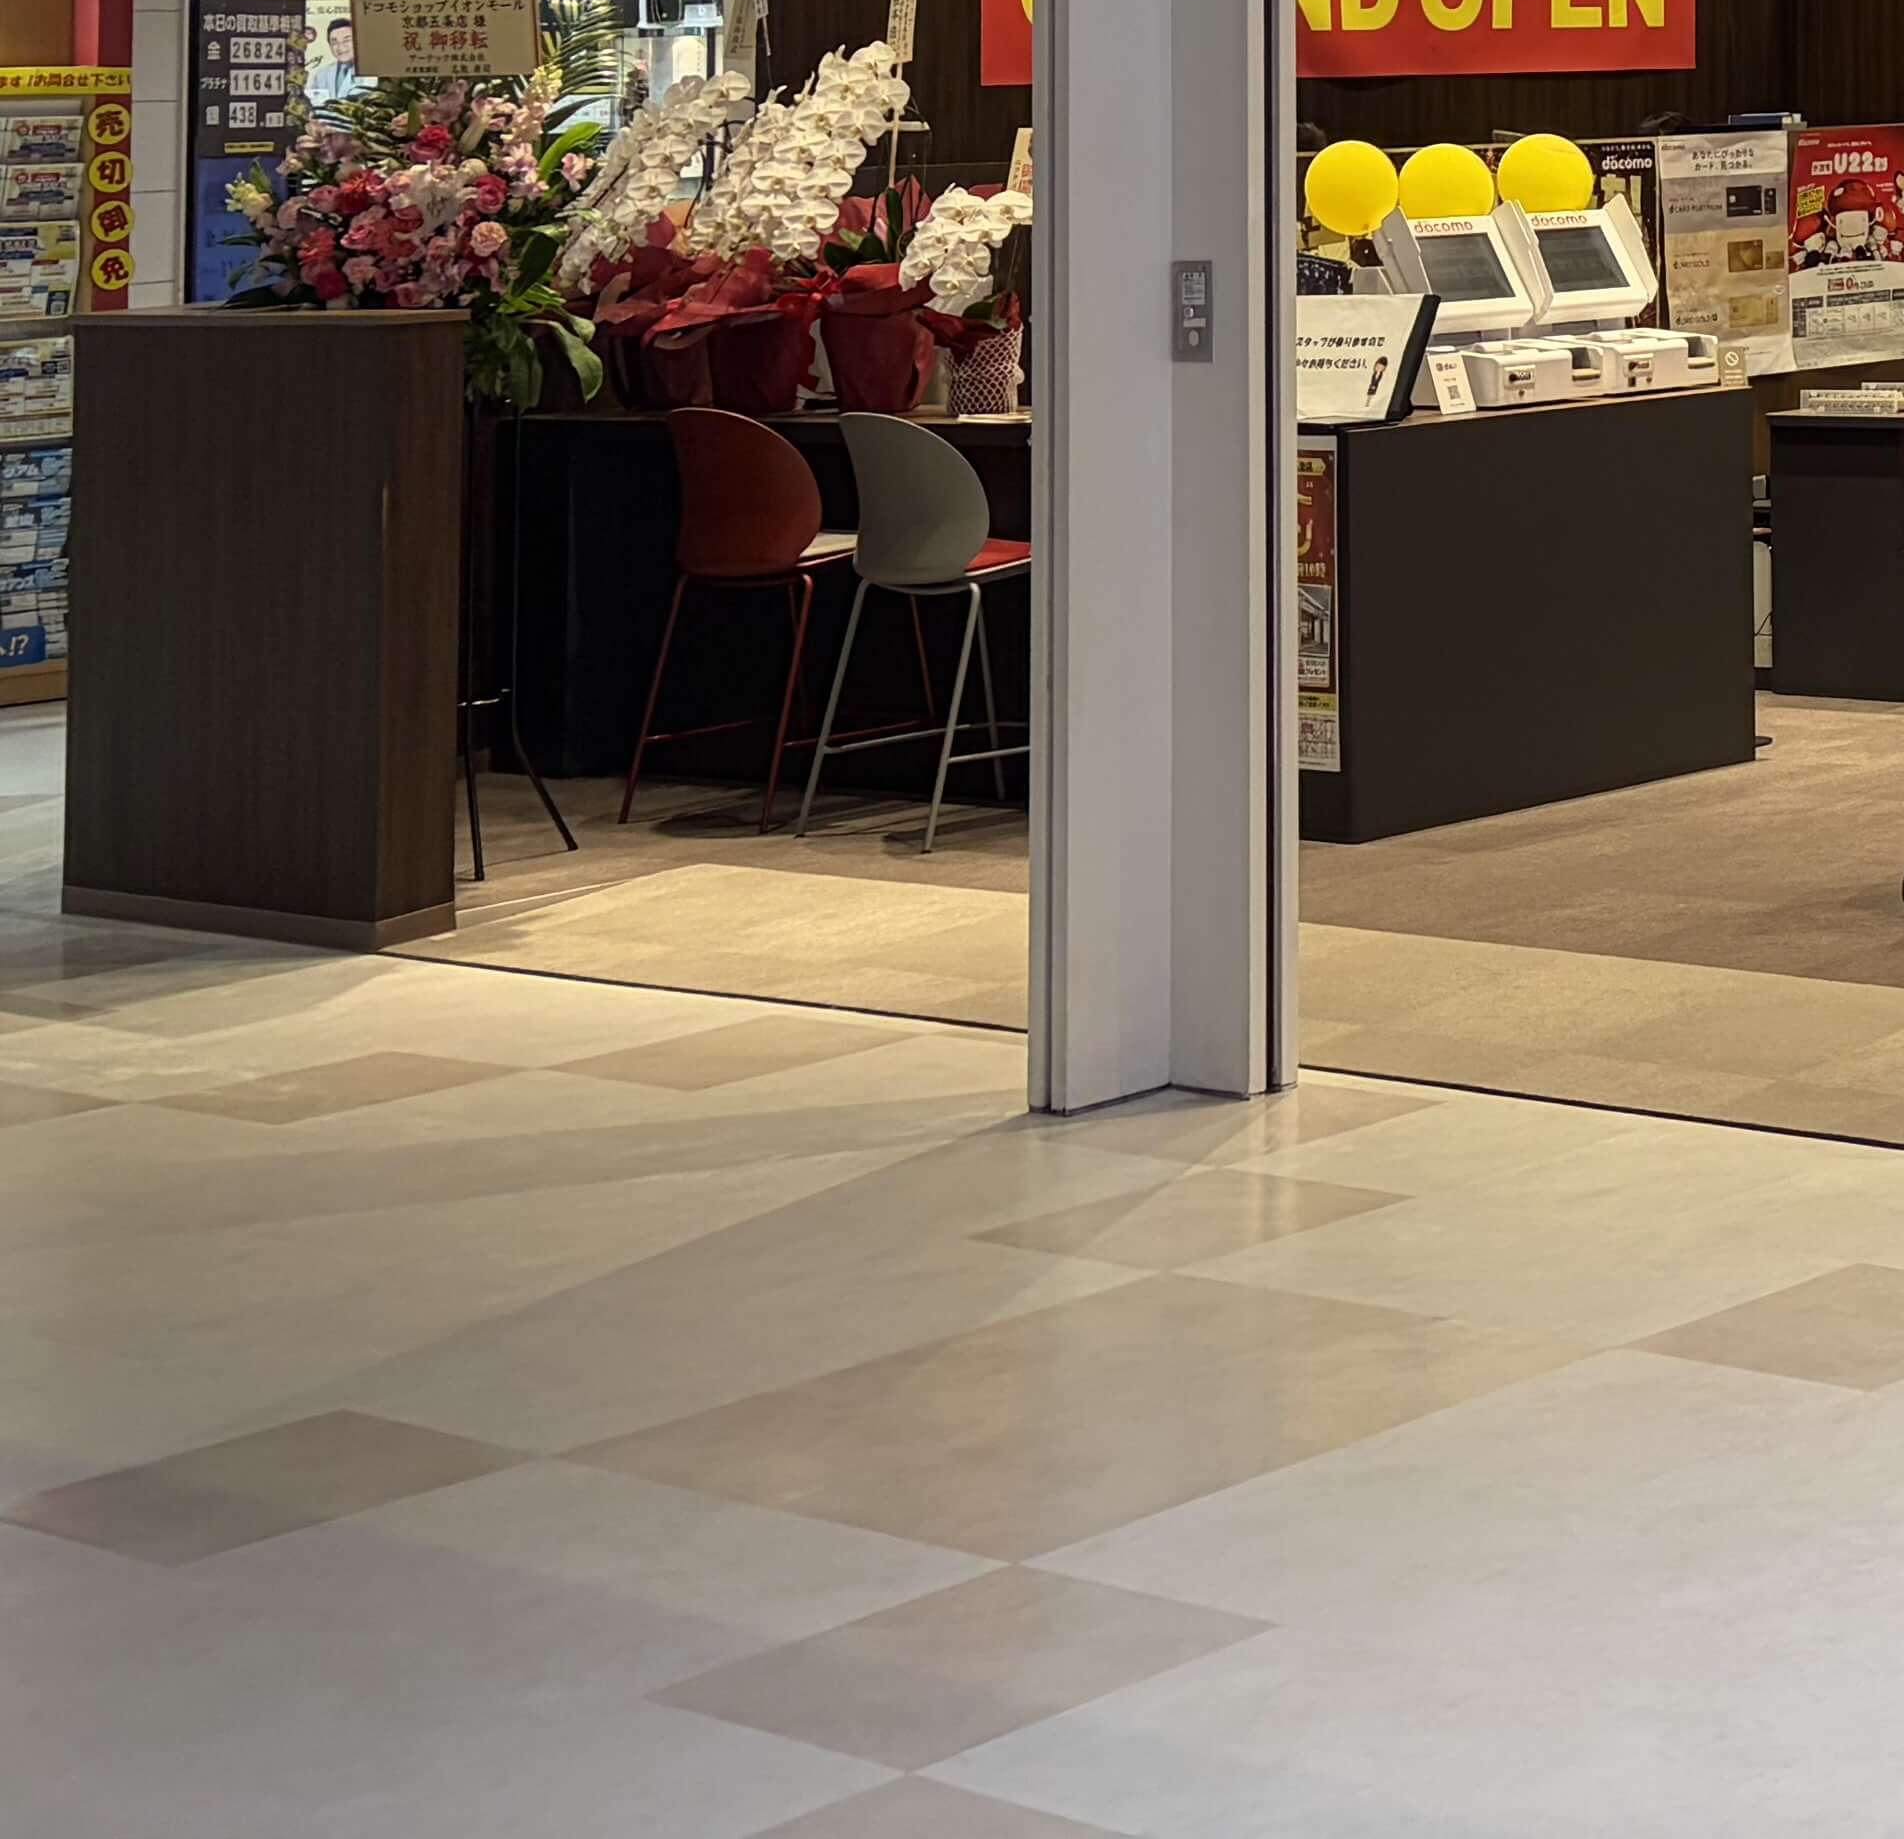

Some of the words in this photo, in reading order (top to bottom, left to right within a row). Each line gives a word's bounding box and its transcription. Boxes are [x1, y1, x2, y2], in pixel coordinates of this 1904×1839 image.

[232, 40, 285, 60] 26824
[233, 73, 284, 93] 11641
[1602, 155, 1653, 170] docomo
[1414, 220, 1473, 235] docomo
[1531, 213, 1588, 227] docomo
